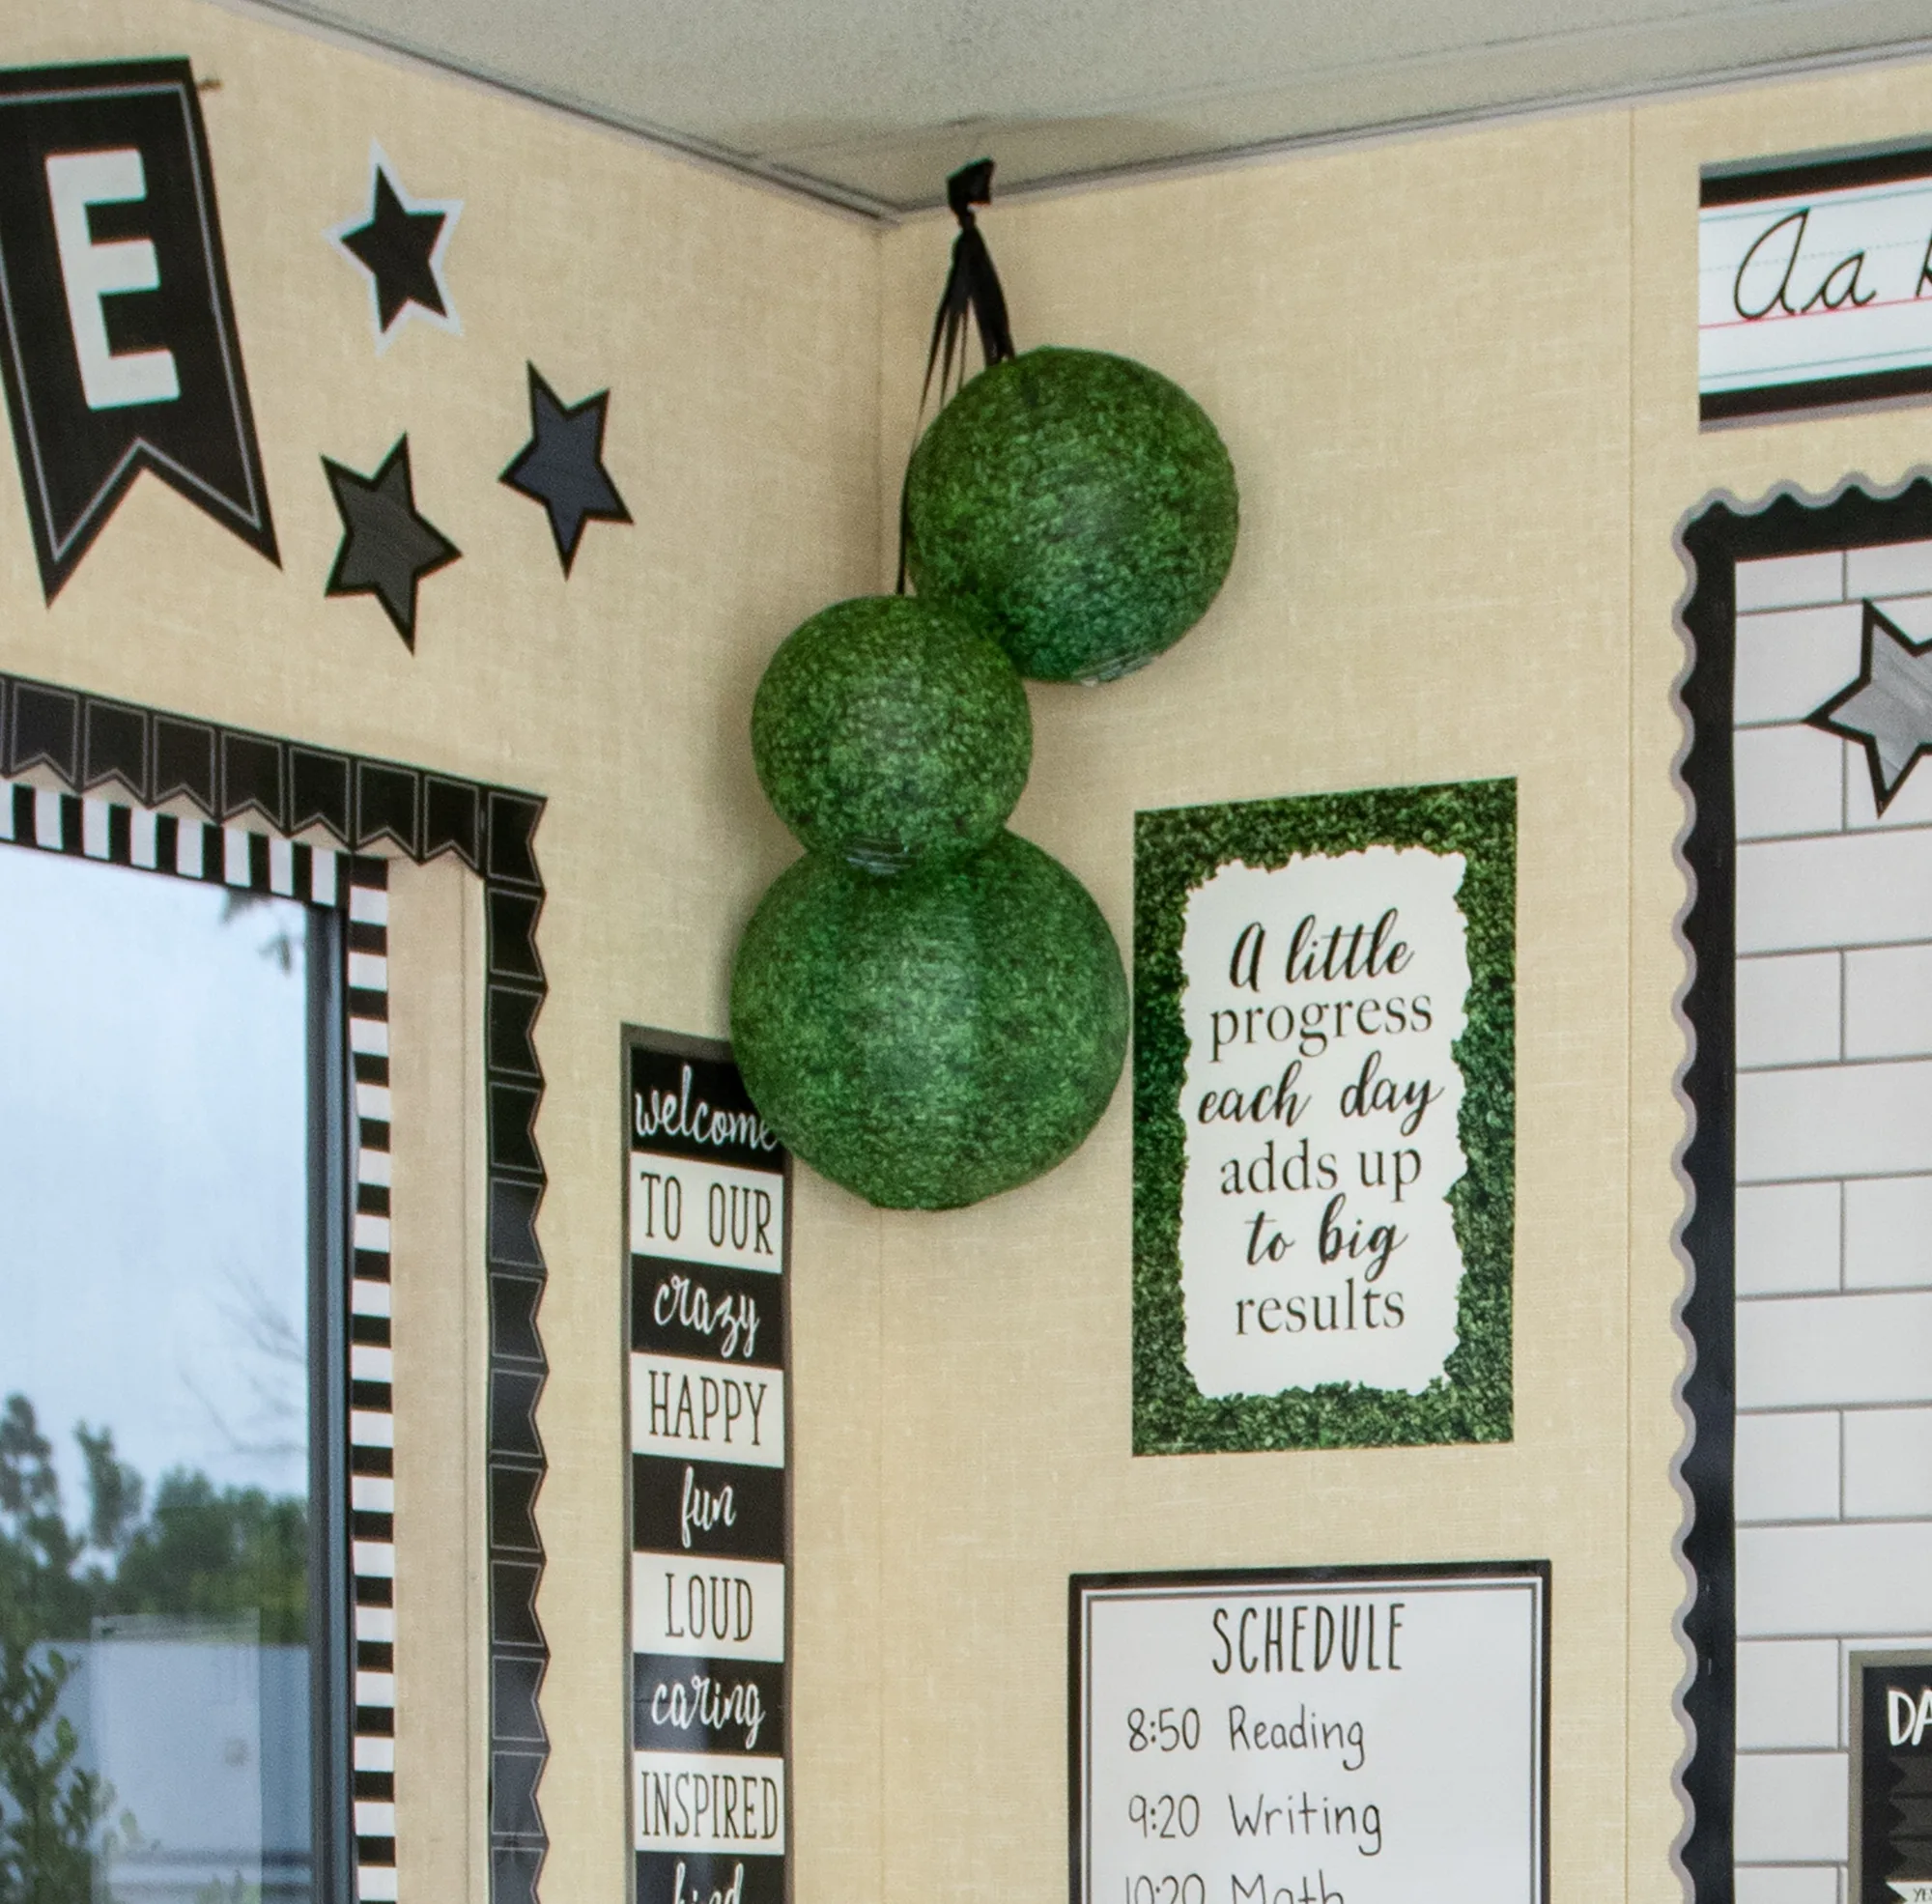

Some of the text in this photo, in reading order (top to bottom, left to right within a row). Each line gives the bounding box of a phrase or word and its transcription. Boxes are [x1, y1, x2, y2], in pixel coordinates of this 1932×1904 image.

[45, 148, 181, 411] E
[1733, 207, 1877, 322] Aa
[1229, 907, 1415, 993] A little
[1210, 993, 1434, 1064] progress
[1197, 1049, 1446, 1138] each day
[1219, 1137, 1423, 1203] adds up
[639, 1172, 774, 1257] TO OUR
[1244, 1192, 1410, 1284] to big
[653, 1273, 760, 1359] crazy
[1235, 1276, 1406, 1336] results
[648, 1370, 768, 1446] HAPPY
[681, 1466, 737, 1549] fun
[665, 1573, 753, 1642] LOUD
[1211, 1603, 1406, 1675] SCHEDULE
[650, 1674, 766, 1750] caring
[1126, 1703, 1366, 1772] 8:50 Reading
[640, 1770, 779, 1840] INSPIRED
[1128, 1791, 1382, 1857] 9:20 Writing
